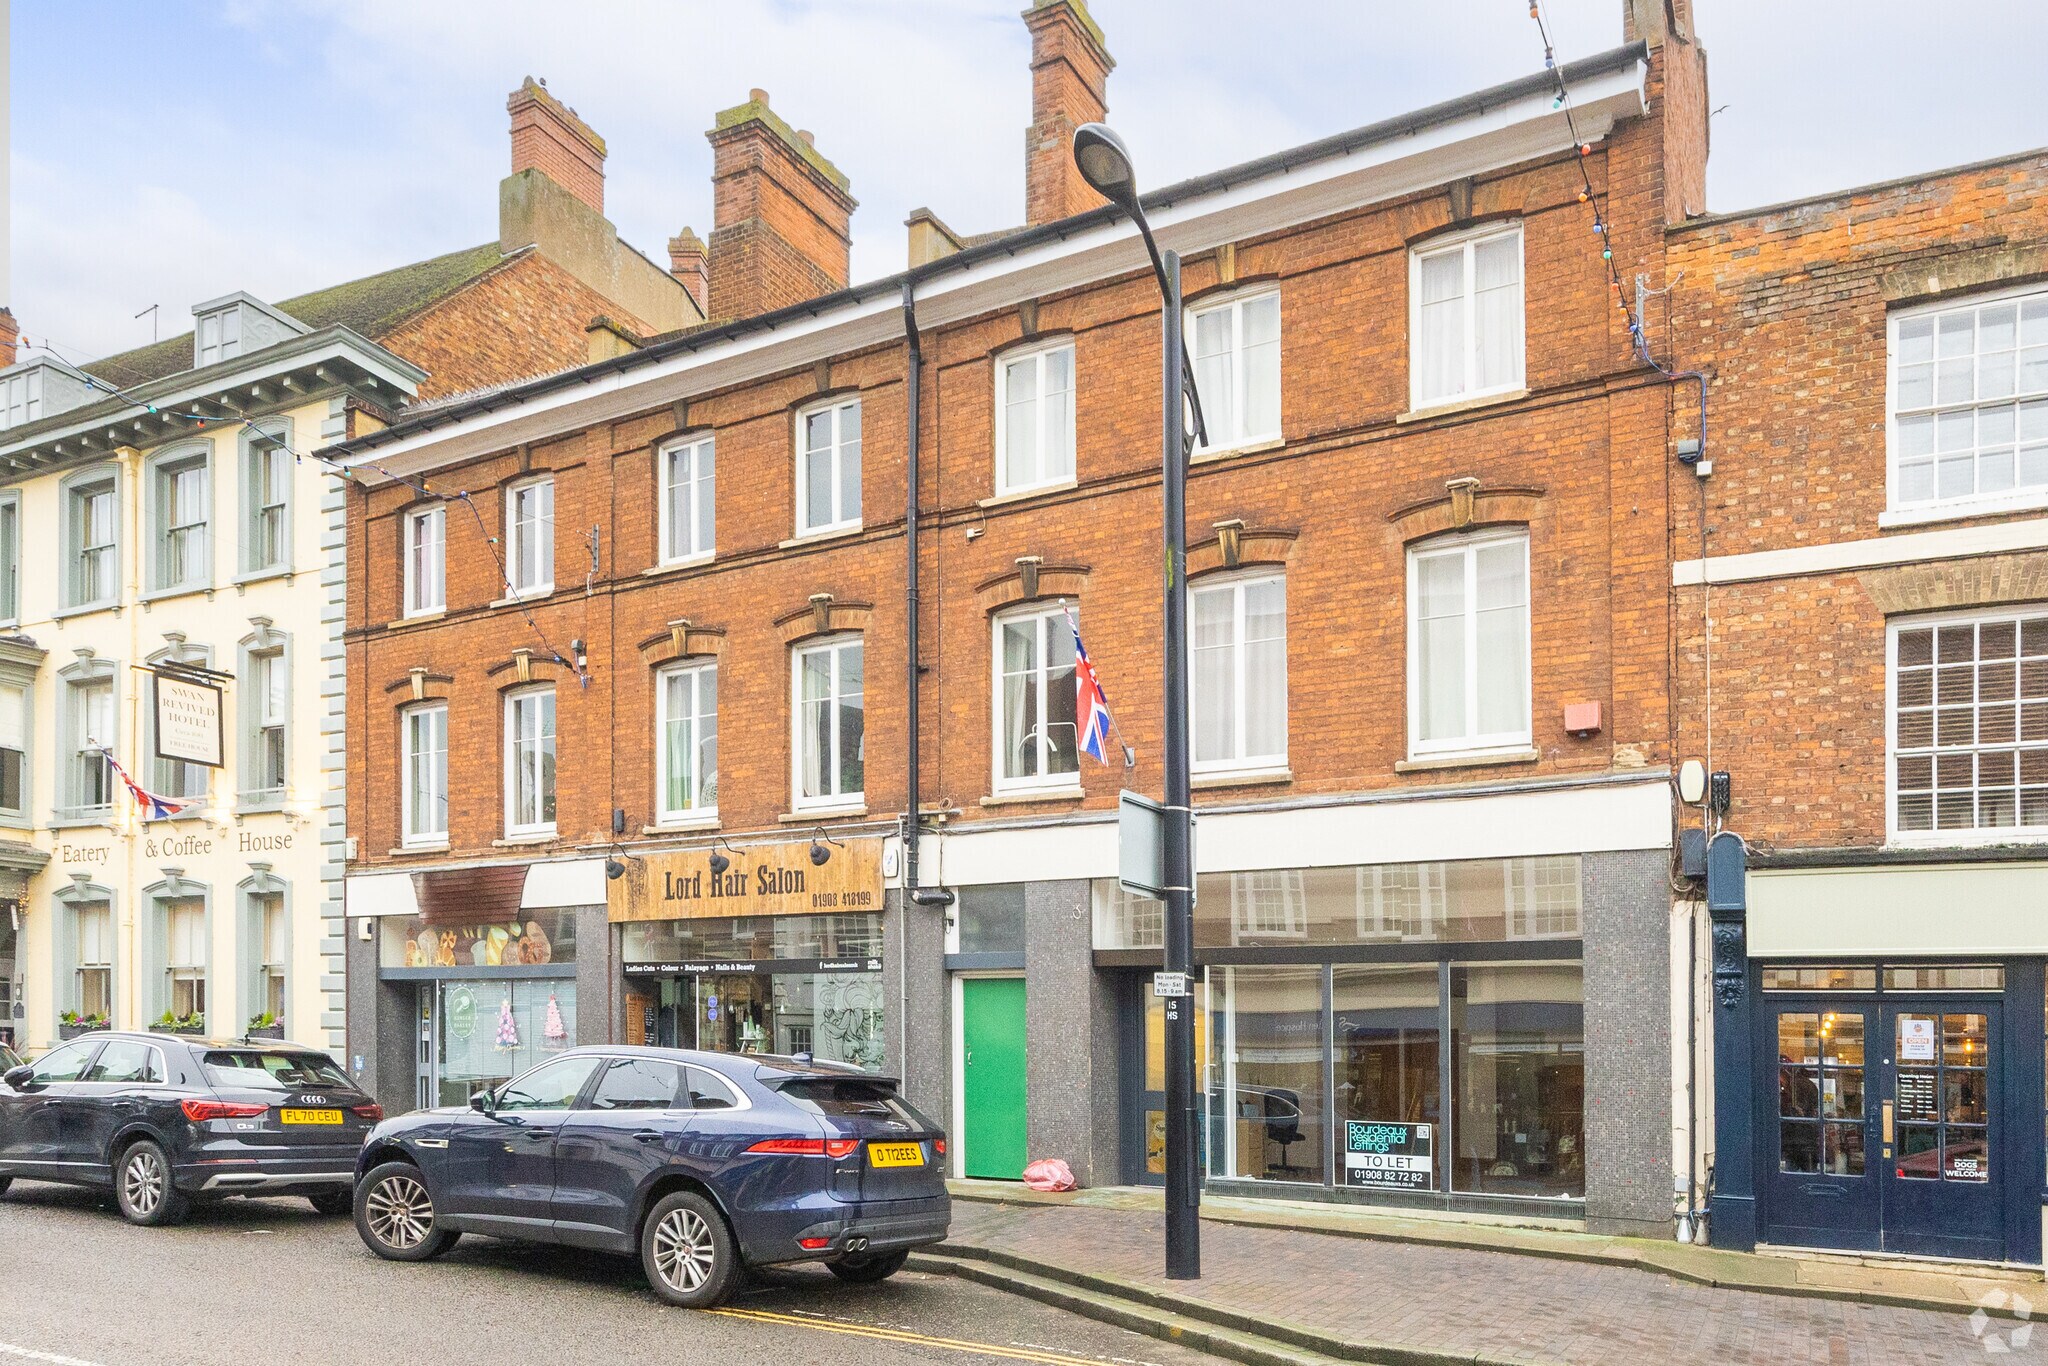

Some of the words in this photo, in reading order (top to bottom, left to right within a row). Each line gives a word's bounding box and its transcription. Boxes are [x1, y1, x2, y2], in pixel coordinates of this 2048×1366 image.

[171, 687, 206, 702] SWAN
[163, 697, 215, 717] REVIVED
[169, 712, 210, 729] HOTEL
[62, 844, 110, 865] Eatery
[145, 839, 158, 858] &
[162, 835, 212, 858] Coffee
[239, 832, 293, 852] House
[664, 871, 702, 900] Lord
[710, 869, 749, 897] Hair
[757, 865, 806, 896] Salon
[812, 892, 838, 908] 01908
[660, 964, 679, 972] Colour
[715, 963, 730, 971] Nails
[736, 963, 756, 972] Beauty
[1167, 1011, 1178, 1020] HS
[286, 1111, 315, 1122] FL70
[317, 1111, 338, 1122] CEU
[1349, 1122, 1407, 1135] Bourdeaux
[1349, 1132, 1406, 1144] Residential
[1349, 1141, 1389, 1154] Lettings
[1364, 1155, 1383, 1167] TO
[1387, 1156, 1413, 1169] LET
[1354, 1169, 1382, 1180] 01908
[1384, 1170, 1396, 1181] 82
[1397, 1171, 1409, 1181] 72
[1411, 1172, 1423, 1182] 82
[1945, 1170, 1987, 1178] WELCOME
